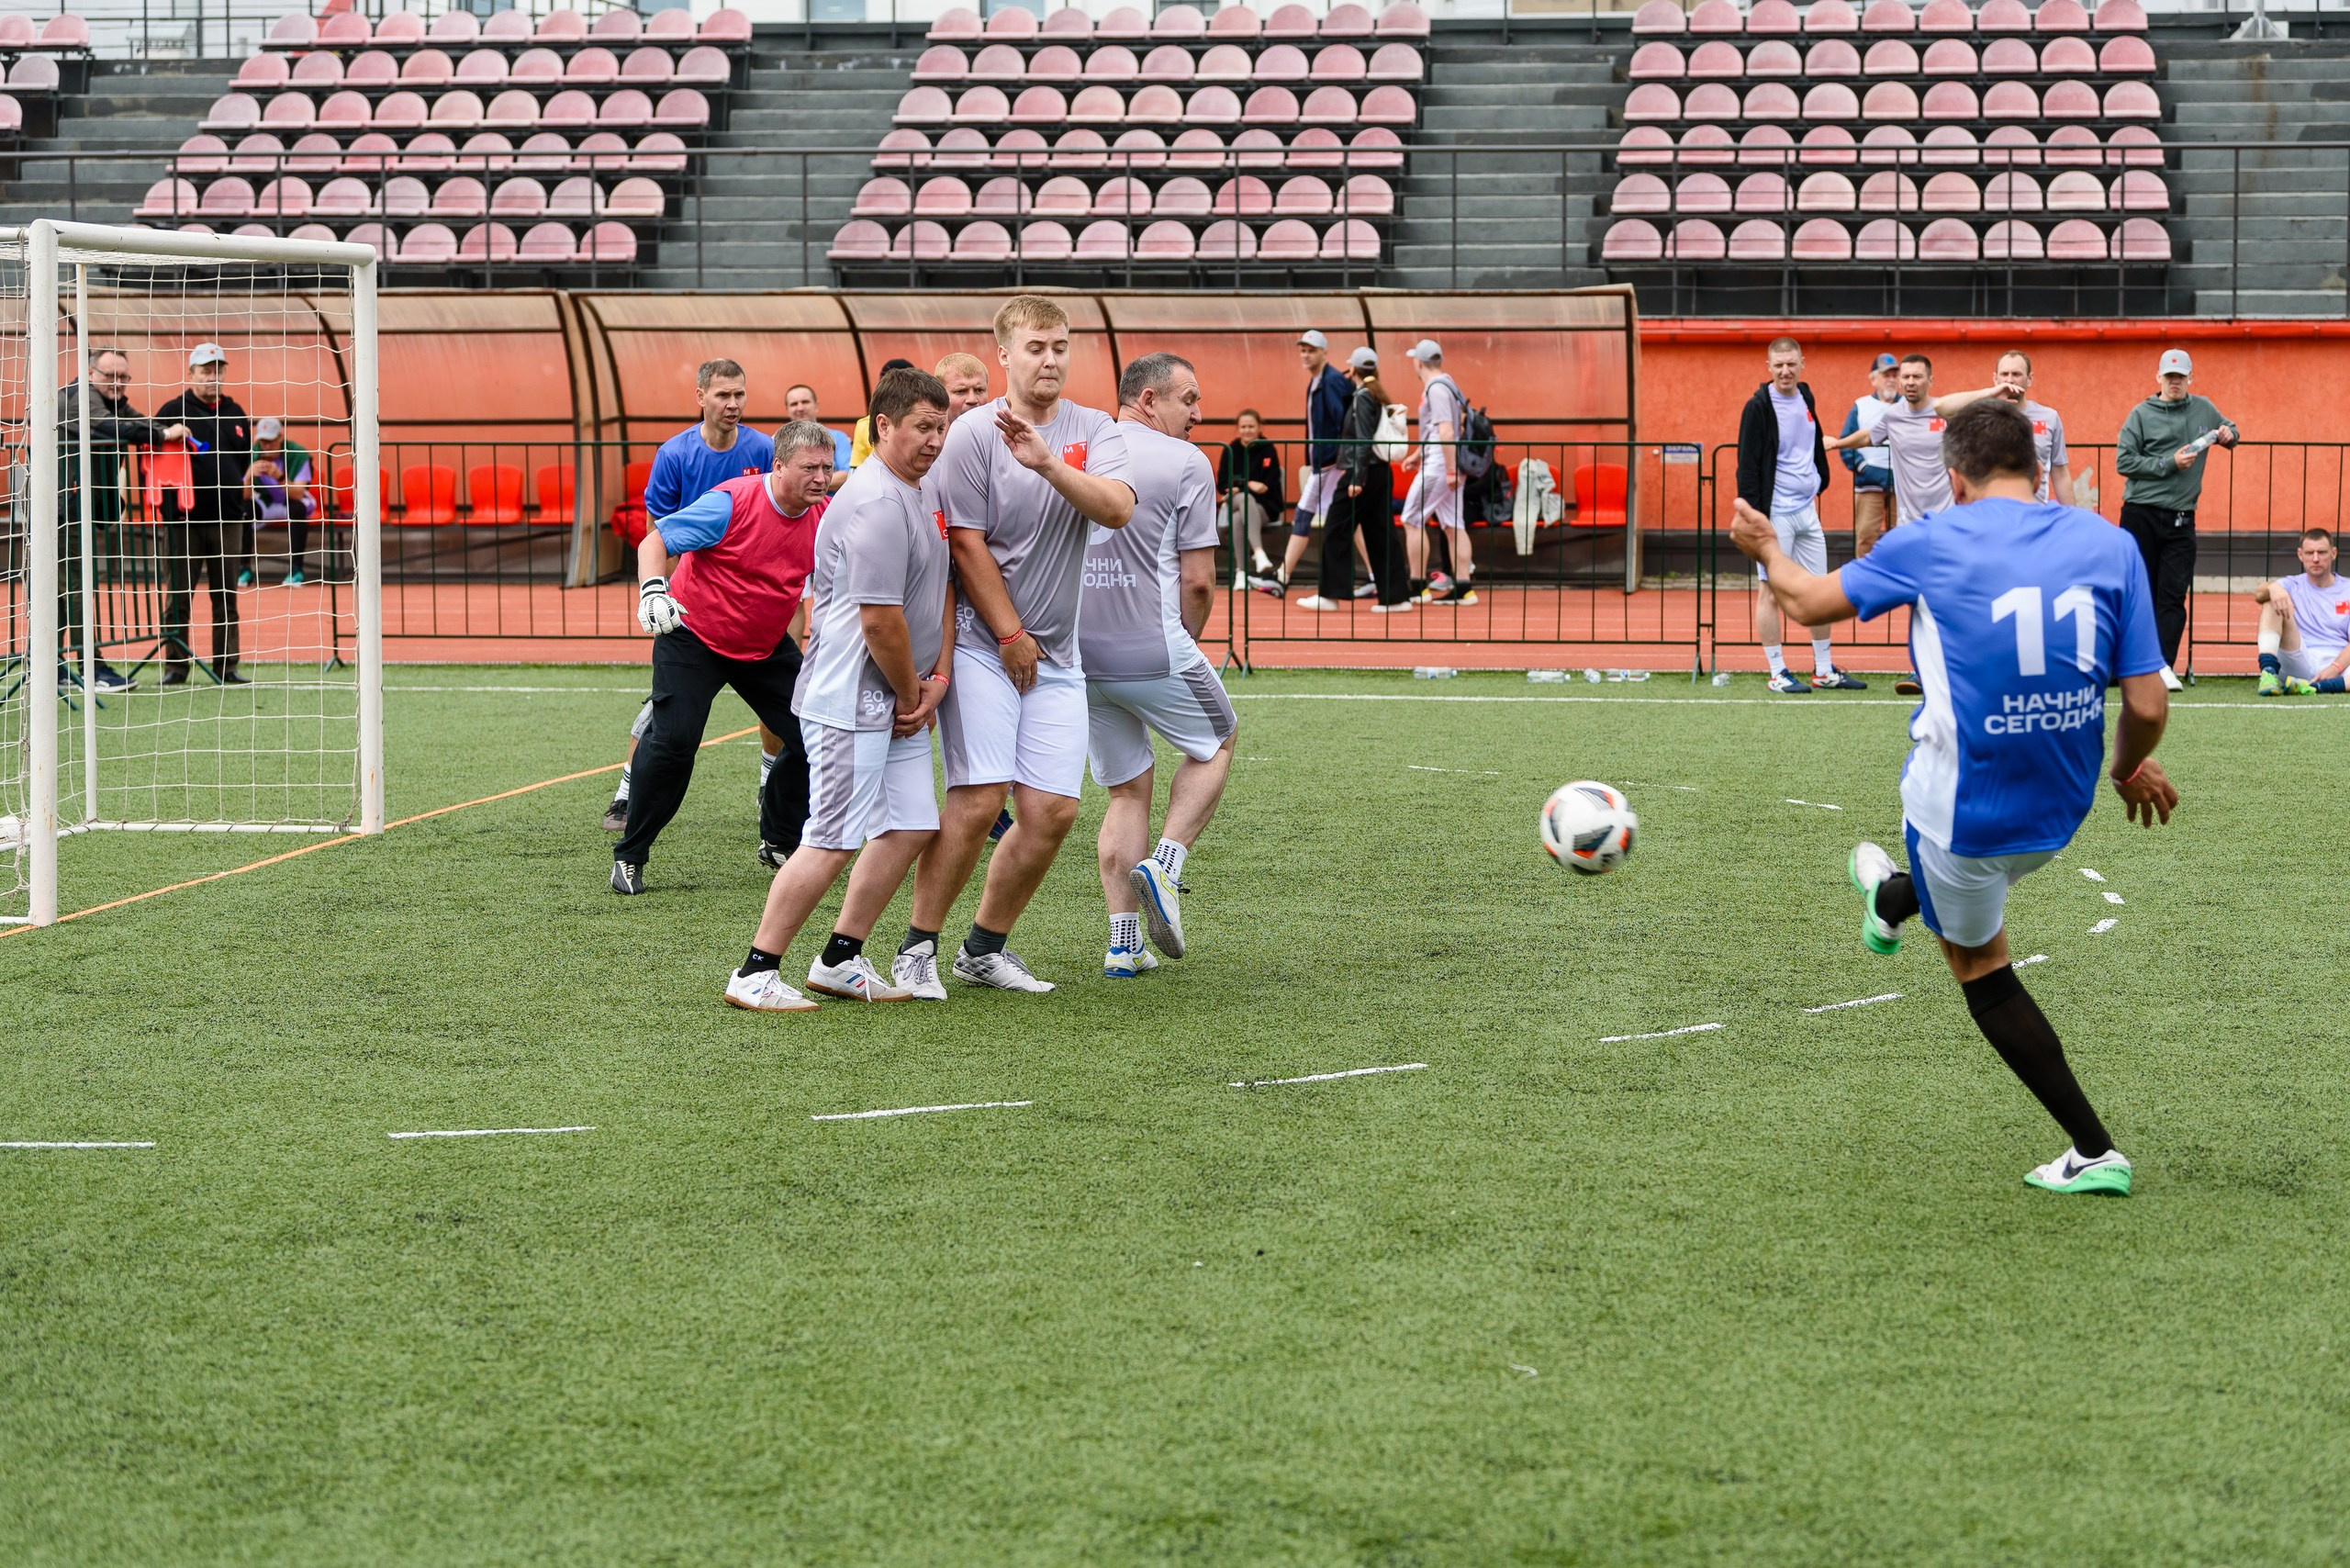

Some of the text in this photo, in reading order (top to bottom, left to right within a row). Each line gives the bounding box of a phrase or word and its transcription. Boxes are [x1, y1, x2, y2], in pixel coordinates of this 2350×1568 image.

[1085, 557, 1123, 572] ЧНИ
[1083, 573, 1136, 588] ОДНЯ
[1991, 586, 2098, 677] 11
[863, 690, 884, 703] 20
[2003, 684, 2096, 713] НАЧНИ
[865, 702, 888, 716] 24
[1984, 697, 2103, 734] СЕГОДНЯ
